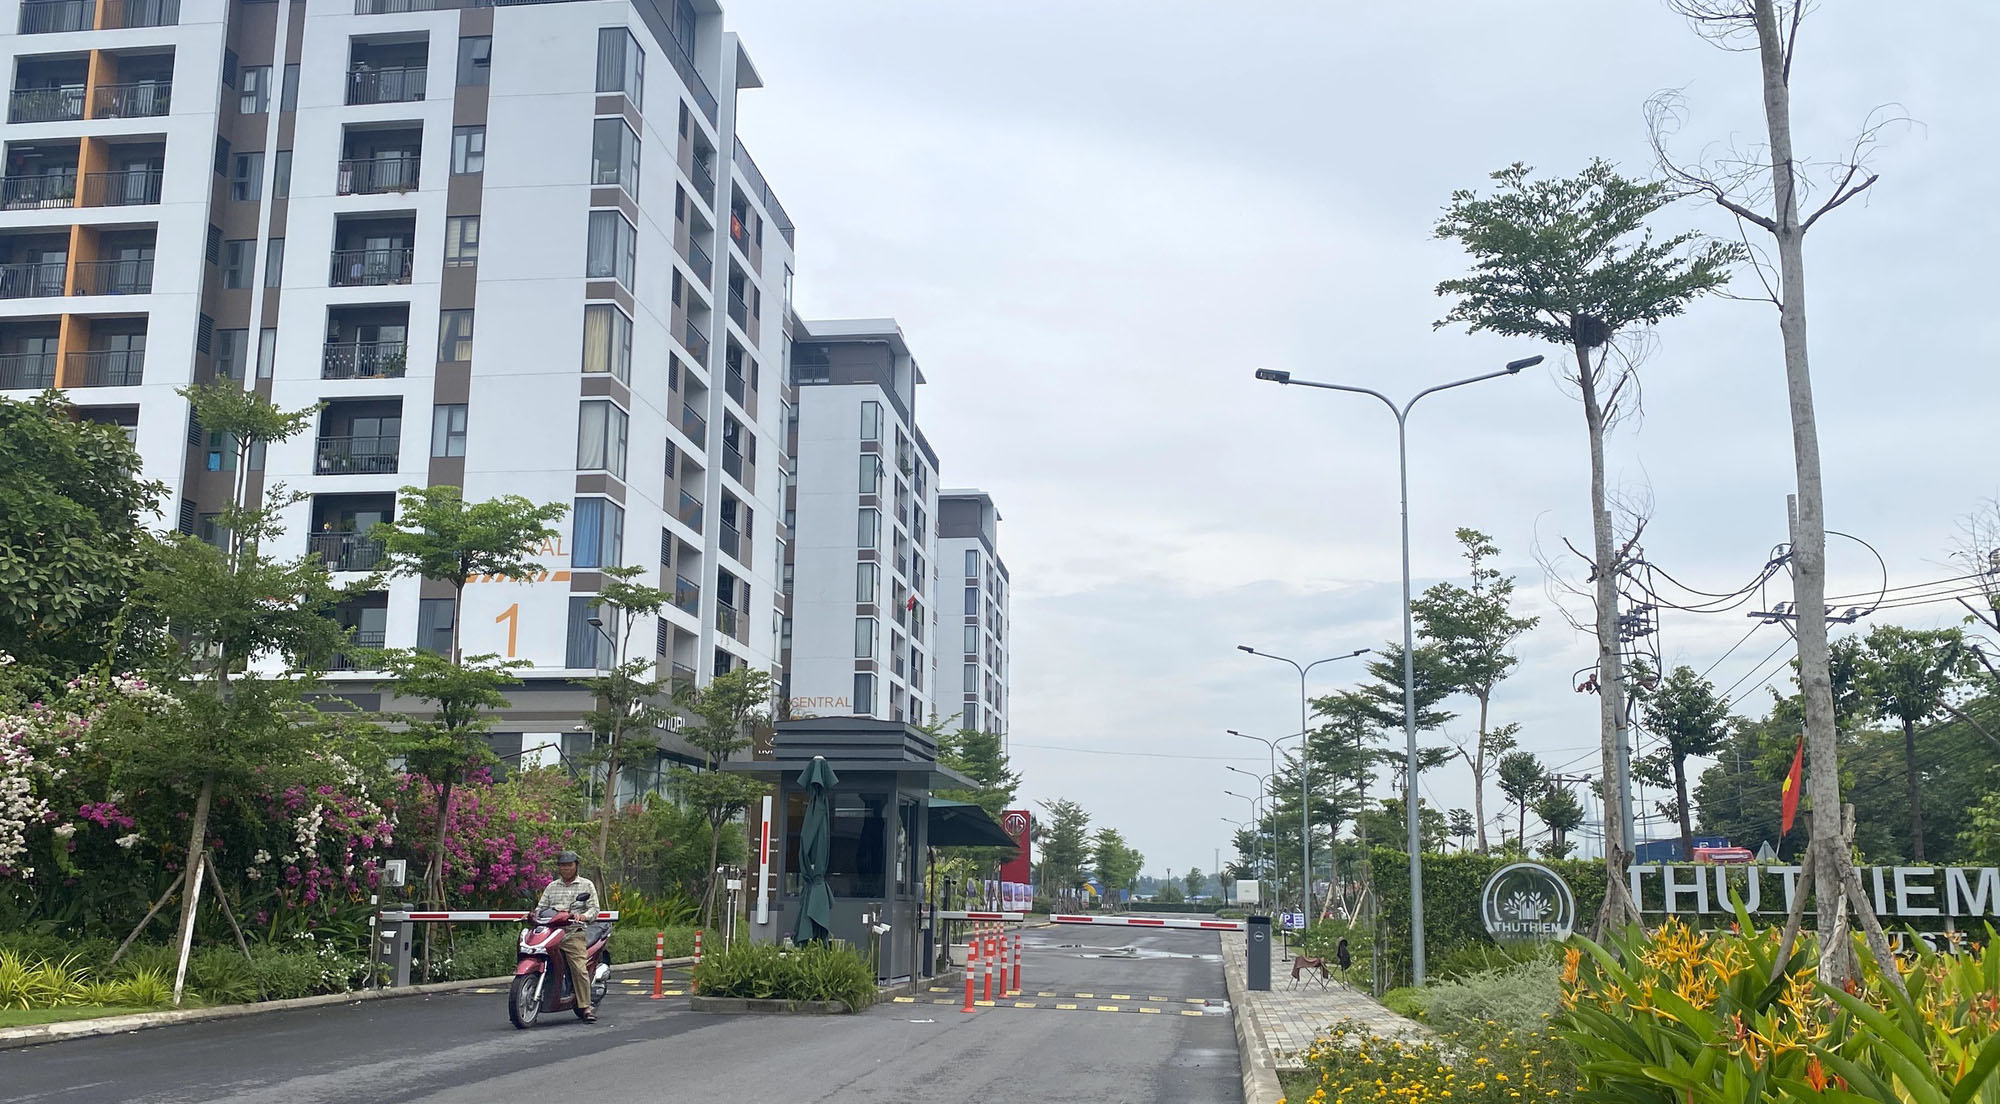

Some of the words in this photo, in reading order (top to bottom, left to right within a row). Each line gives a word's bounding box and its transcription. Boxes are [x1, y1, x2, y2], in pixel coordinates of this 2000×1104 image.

[496, 603, 518, 657] 1
[791, 696, 852, 708] CENTRAL
[1626, 865, 2000, 918] THUTIEM
[1493, 921, 1562, 933] THUTHIEM
